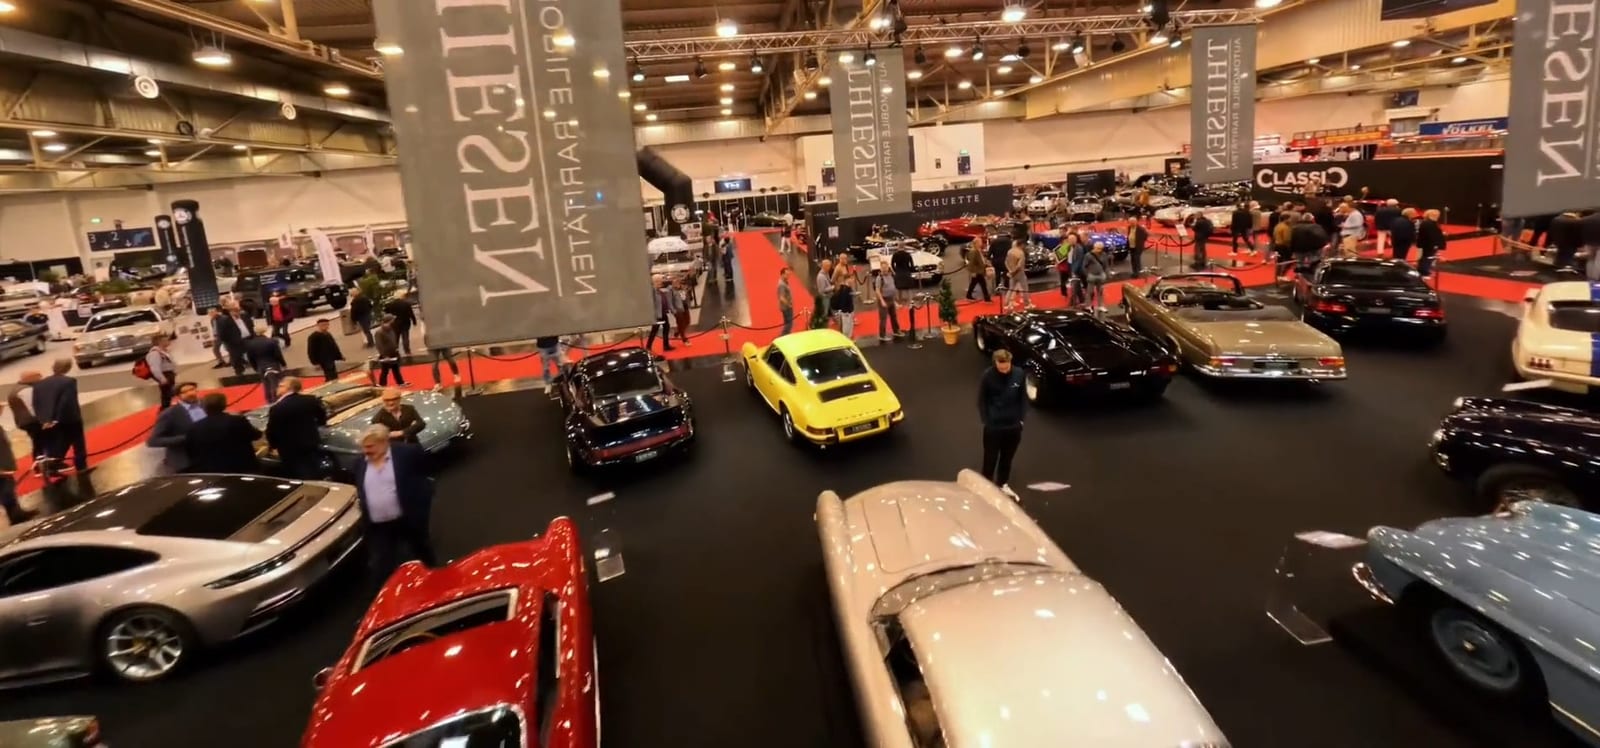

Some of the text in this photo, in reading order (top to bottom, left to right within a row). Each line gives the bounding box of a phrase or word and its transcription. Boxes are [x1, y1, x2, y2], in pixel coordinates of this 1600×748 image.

[1256, 166, 1349, 189] CLASSIC
[916, 194, 980, 208] SCHUETTE
[89, 231, 120, 244] 3 2
